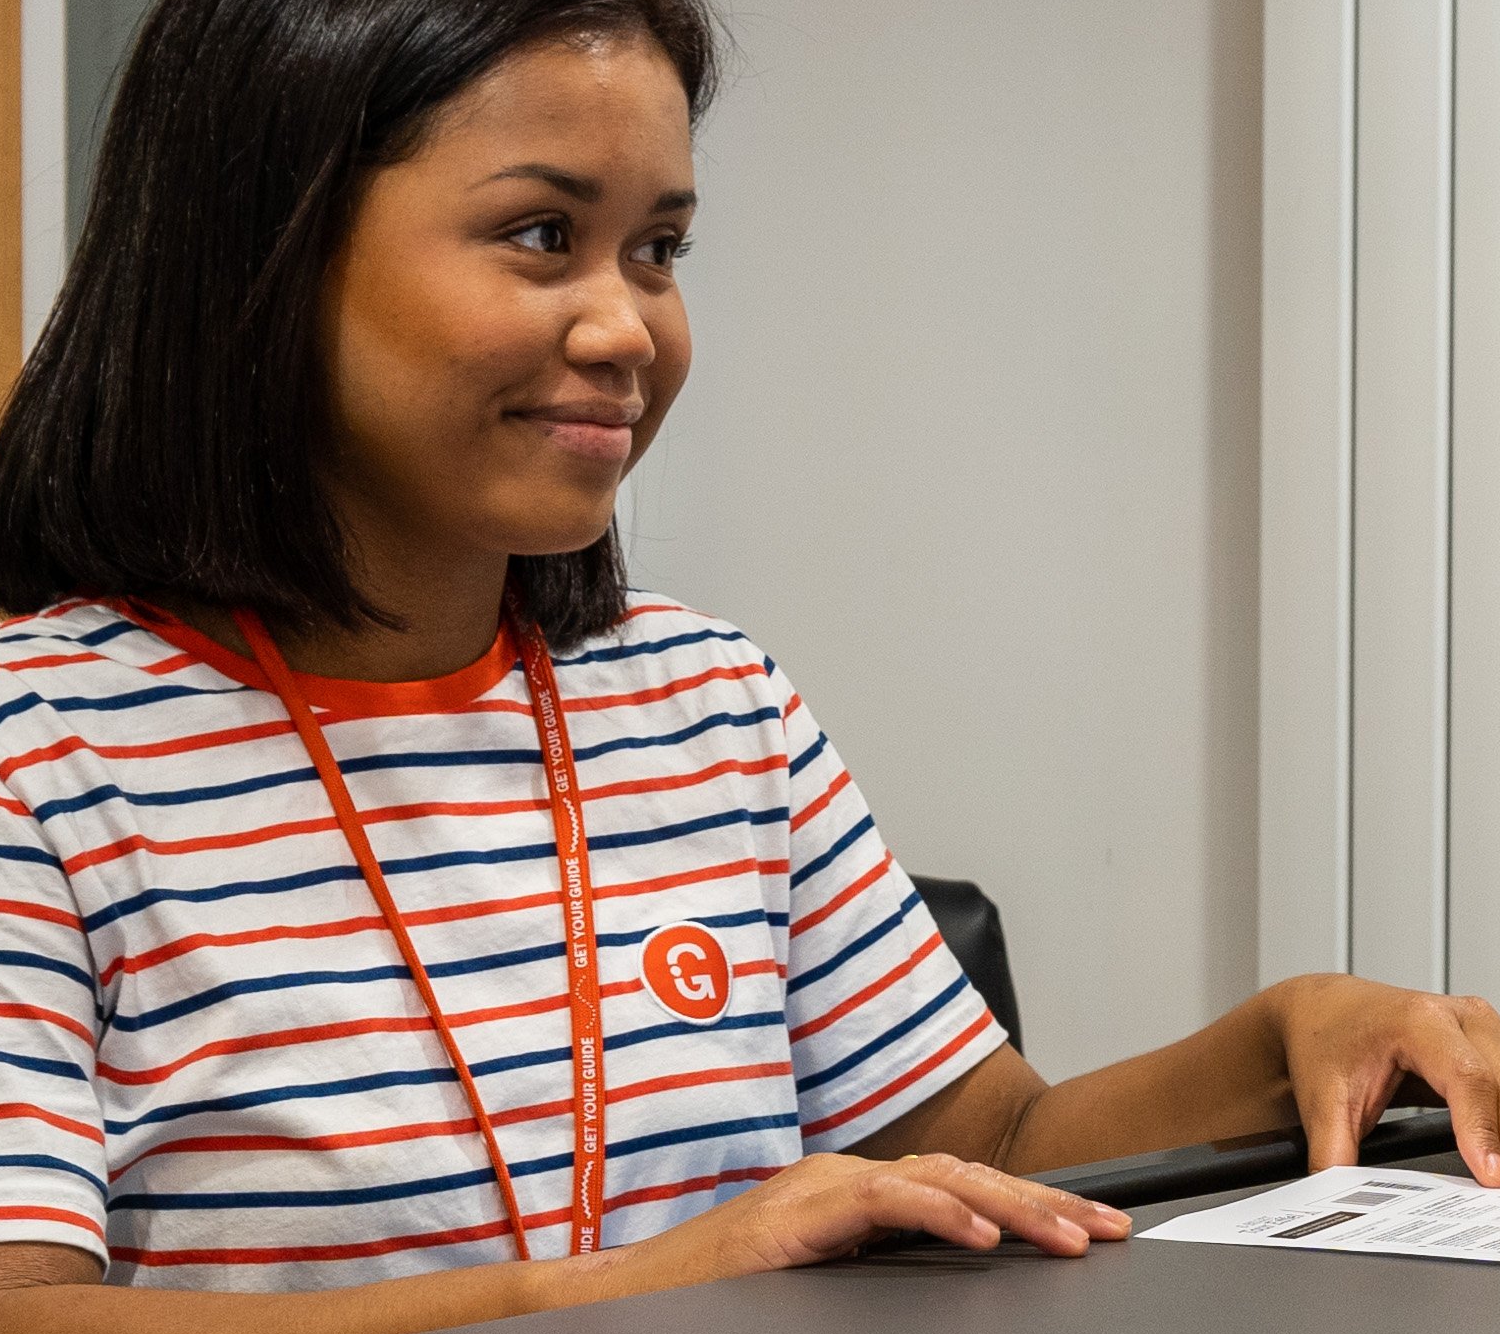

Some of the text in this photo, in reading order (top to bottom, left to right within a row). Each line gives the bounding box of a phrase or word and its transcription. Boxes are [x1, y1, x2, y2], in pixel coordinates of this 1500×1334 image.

[538, 688, 569, 793] GET YOUR GUIDE
[565, 856, 588, 969] GET YOUR GUIDE
[580, 1036, 598, 1154] GET YOUR GUIDE
